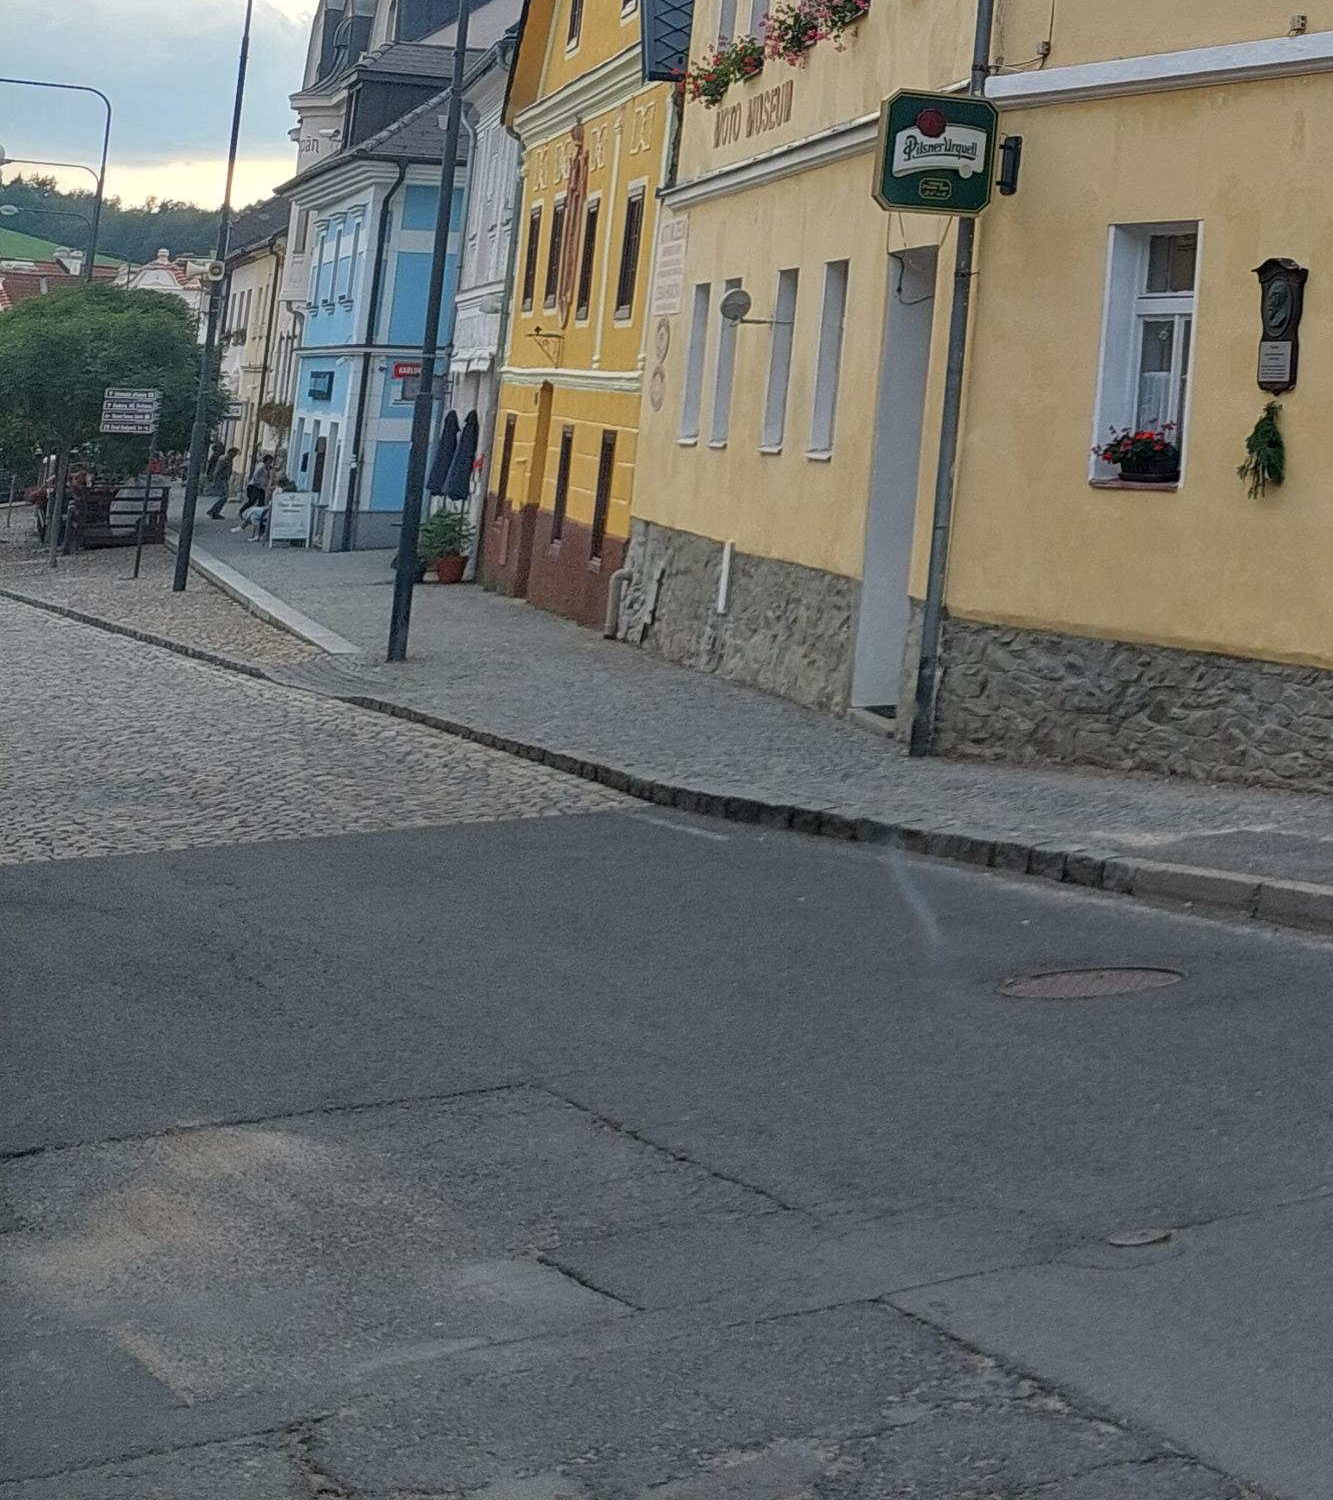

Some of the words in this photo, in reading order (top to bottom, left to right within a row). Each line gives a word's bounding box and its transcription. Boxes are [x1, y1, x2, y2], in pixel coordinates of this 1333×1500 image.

[713, 102, 742, 149] MOTO
[746, 79, 794, 138] MUSEUM
[902, 134, 944, 162] Pilsner
[944, 136, 978, 160] Urquell
